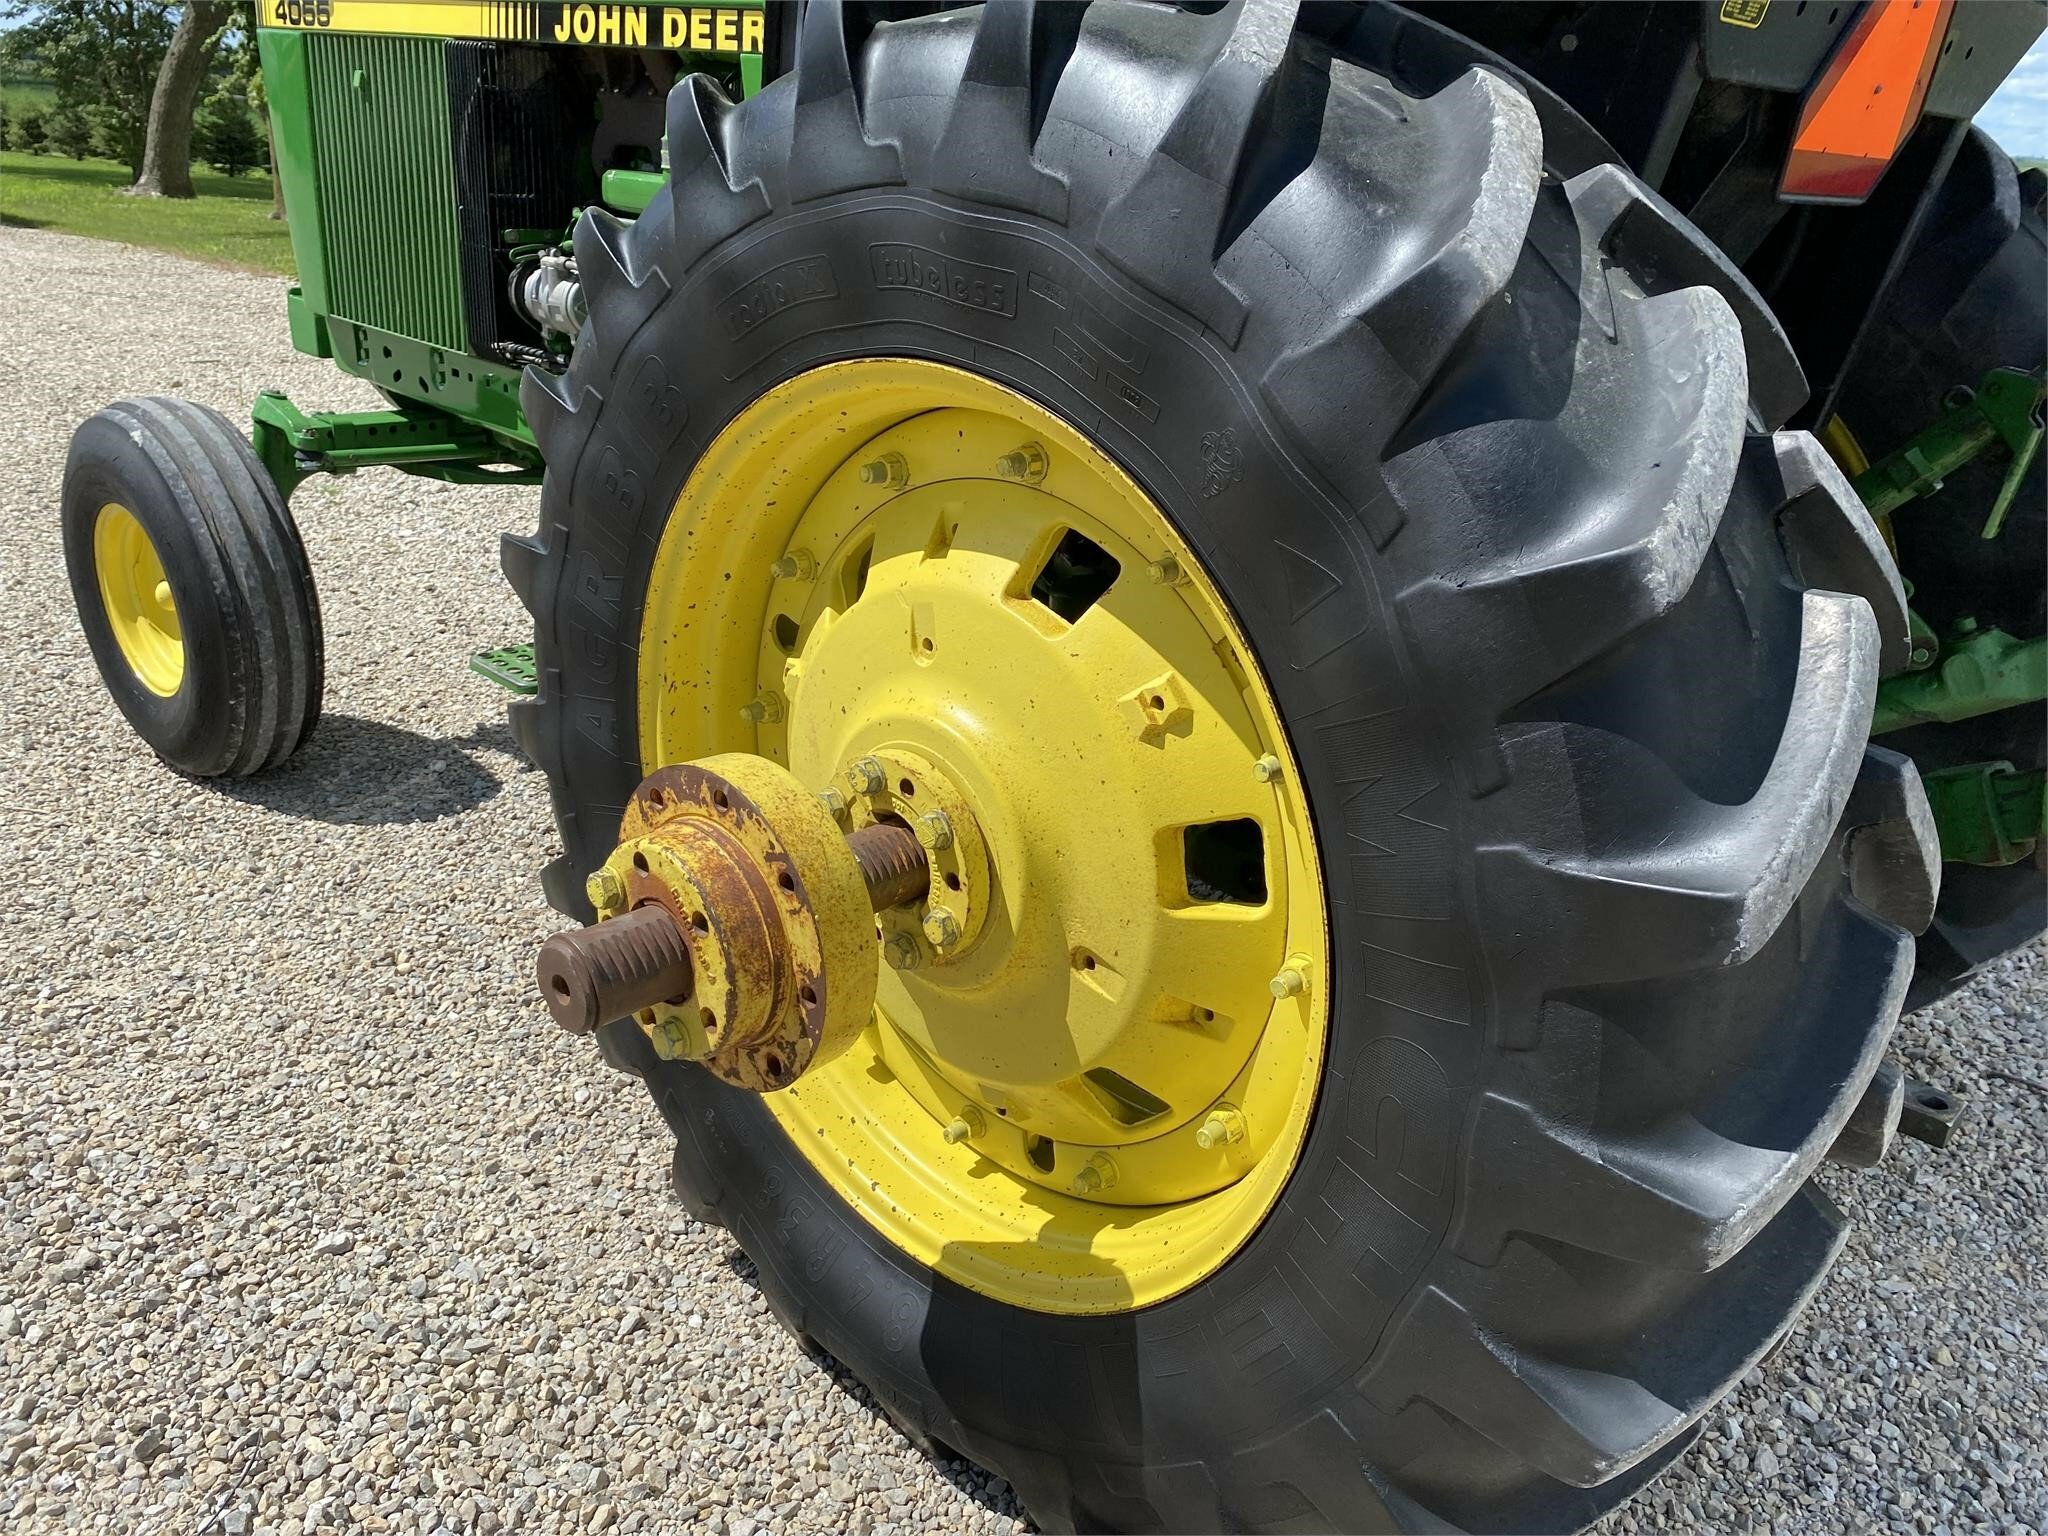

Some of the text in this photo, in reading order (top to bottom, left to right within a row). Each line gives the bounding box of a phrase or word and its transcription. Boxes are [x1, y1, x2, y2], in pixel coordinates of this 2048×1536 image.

[275, 0, 330, 27] 4055
[554, 3, 647, 46] JOHN
[880, 248, 1006, 312] tubeless
